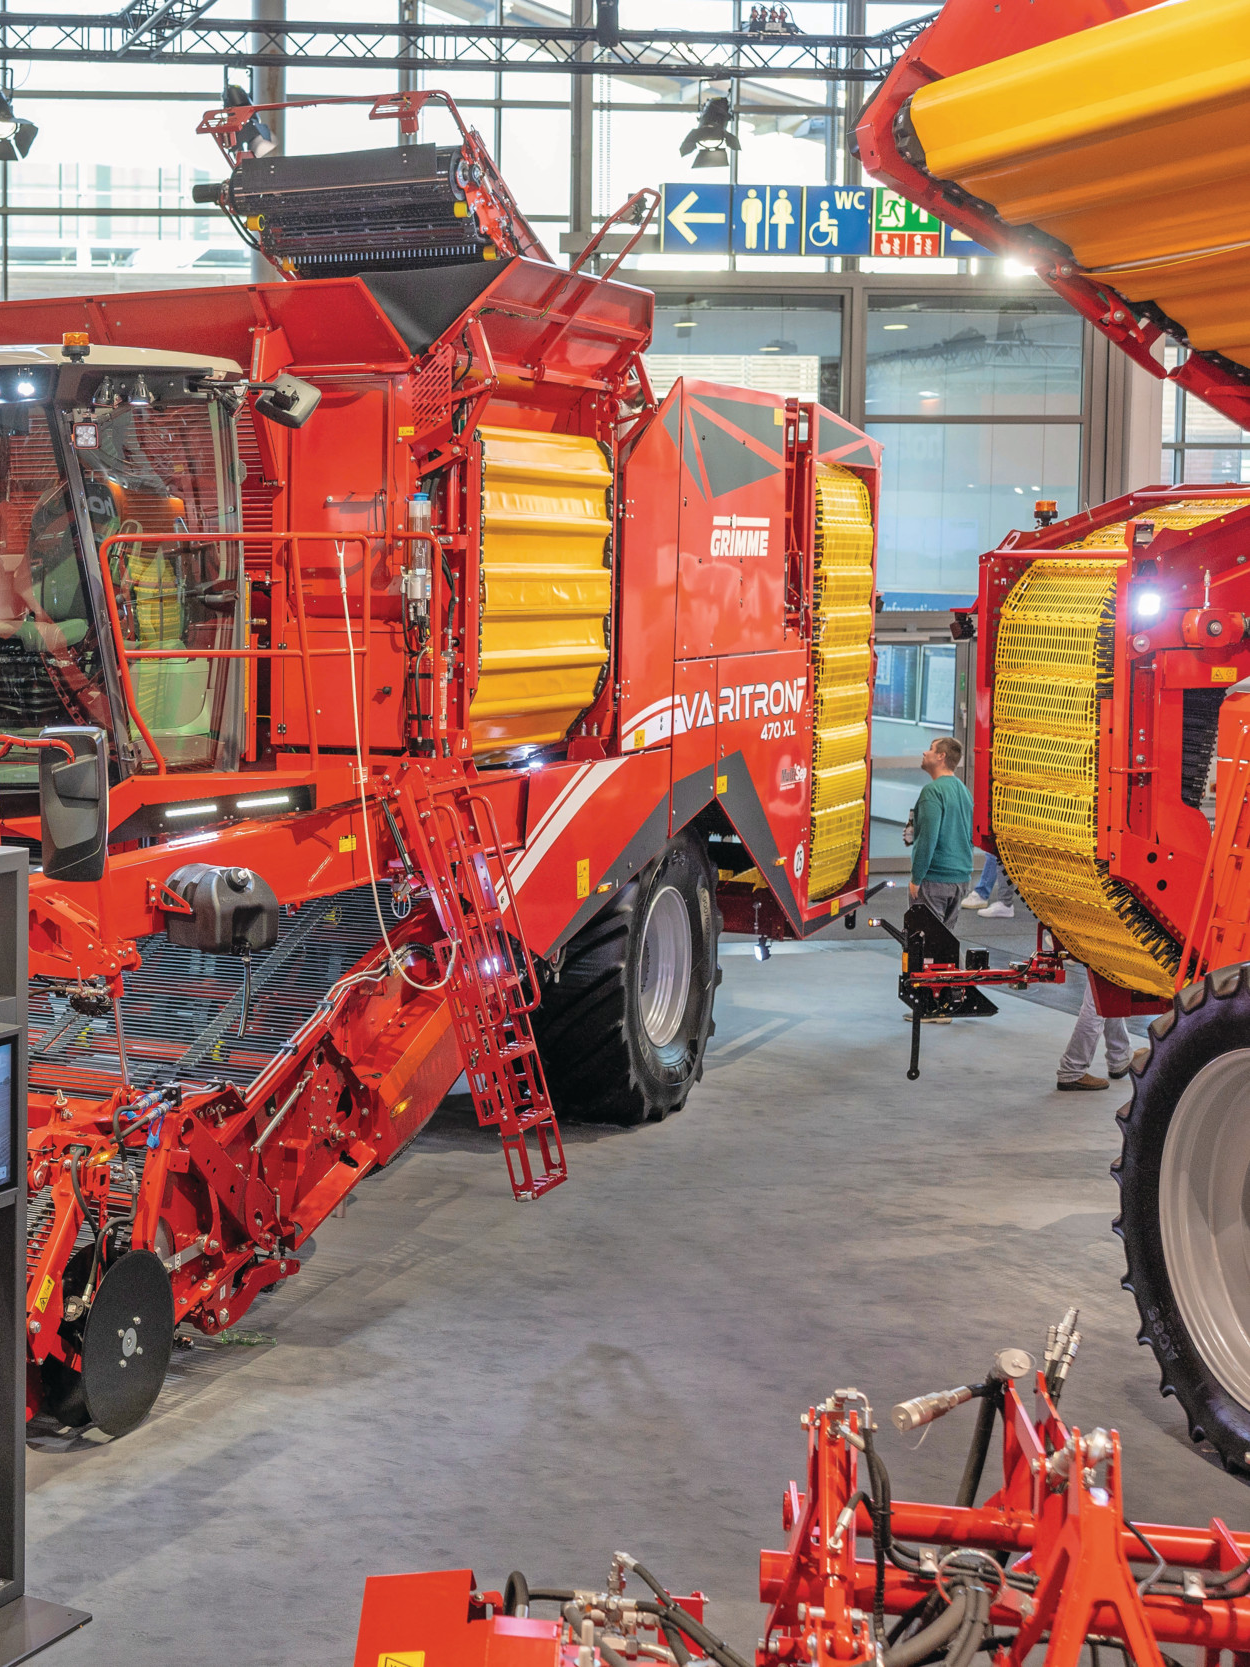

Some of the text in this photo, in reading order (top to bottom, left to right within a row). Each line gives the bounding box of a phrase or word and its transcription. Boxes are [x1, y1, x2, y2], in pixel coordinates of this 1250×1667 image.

[834, 191, 866, 210] WC
[710, 514, 770, 557] GRIMME
[680, 679, 798, 731] VARITRON
[760, 719, 797, 741] 470 XL
[795, 850, 803, 872] 25
